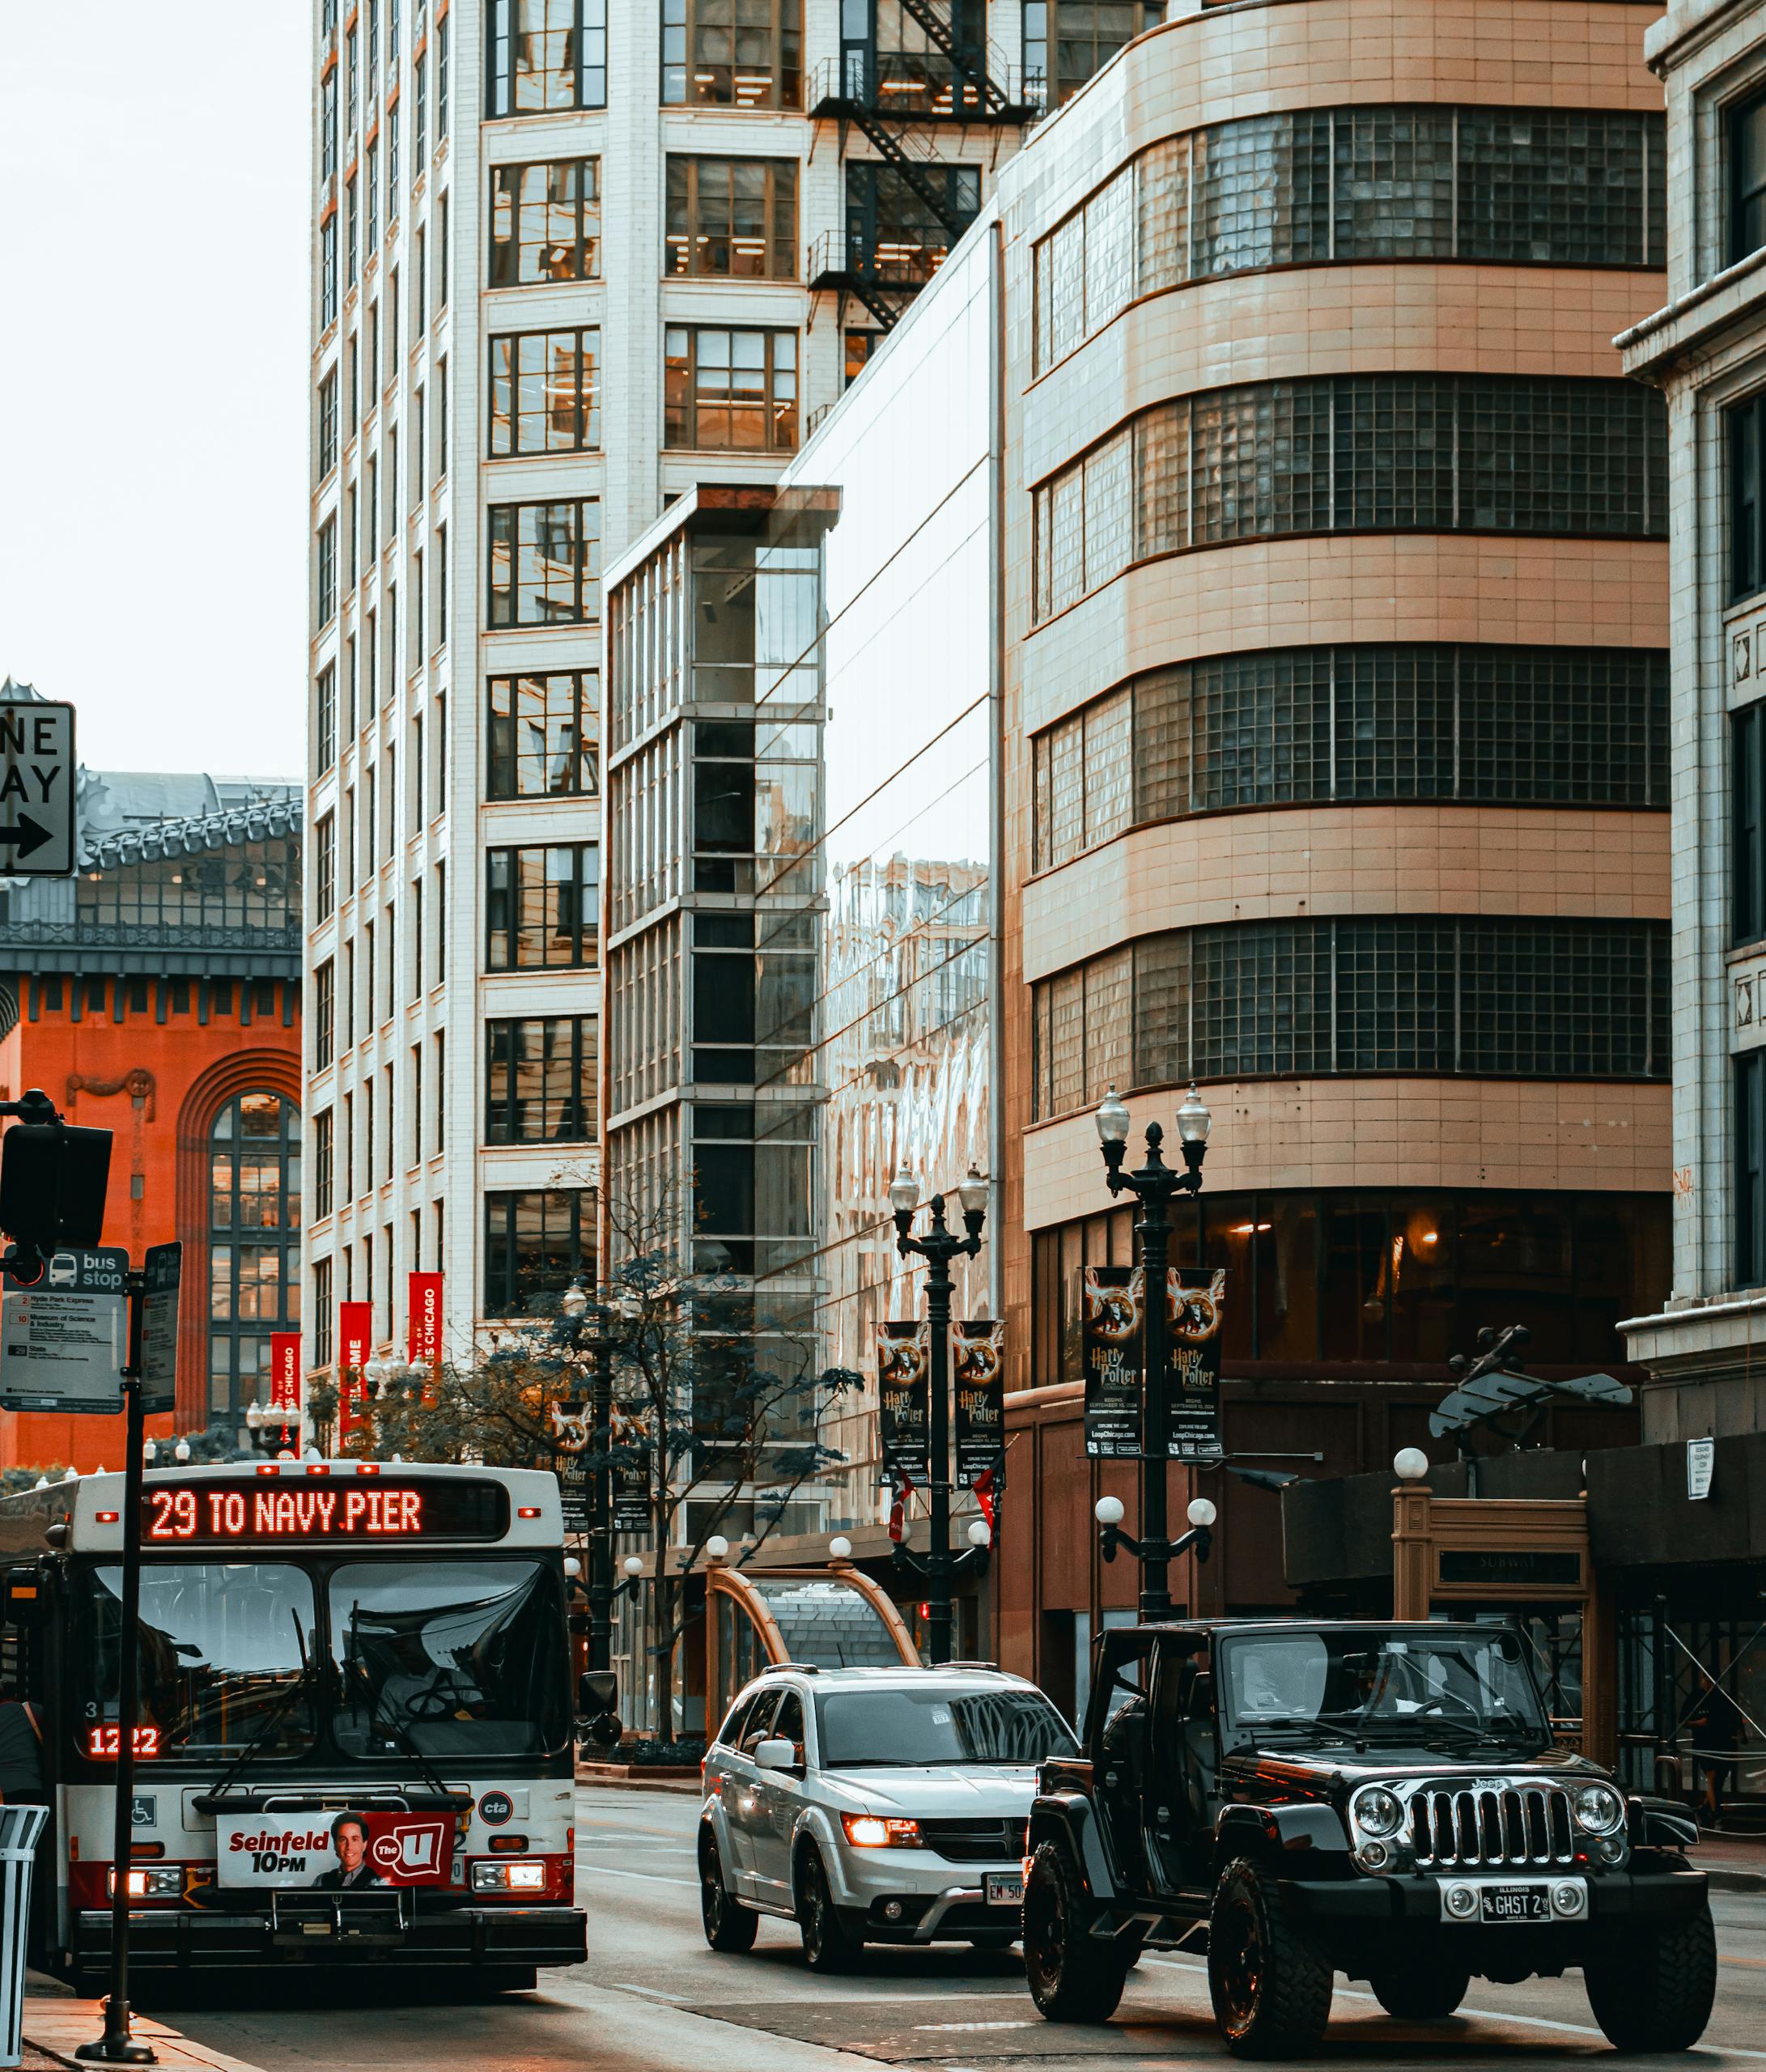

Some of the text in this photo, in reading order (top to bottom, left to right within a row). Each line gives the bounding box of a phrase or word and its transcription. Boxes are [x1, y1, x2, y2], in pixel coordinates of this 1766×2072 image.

[0, 717, 57, 755] NE
[0, 765, 62, 803] AY
[83, 1254, 117, 1270] bus
[83, 1271, 121, 1289] stop
[22, 1297, 28, 1305] 2
[31, 1295, 48, 1304] Hyde
[66, 1297, 95, 1305] Express
[70, 1314, 96, 1323] Science
[424, 1288, 435, 1346] CHICAGO
[1090, 1347, 1124, 1369] Harry
[1170, 1347, 1203, 1370] Harry
[284, 1347, 294, 1395] CHICAGO
[349, 1340, 362, 1419] ELOME
[1100, 1363, 1137, 1386] Potter
[1182, 1365, 1215, 1387] Potter
[883, 1391, 912, 1411] Harry
[958, 1390, 988, 1411] Harry
[894, 1404, 923, 1424] Potter
[969, 1404, 1000, 1424] Potter
[1091, 1430, 1136, 1439] LoopChicago.com
[1173, 1431, 1216, 1440] LoopChicago.com
[556, 1454, 578, 1471] Harry
[562, 1467, 586, 1481] Potter
[151, 1491, 421, 1536] 29 TO NAVY PIER
[85, 1701, 97, 1717] 3
[1471, 1778, 1503, 1790] Jeep
[484, 1801, 507, 1814] cta
[229, 1830, 329, 1856] Seinfeld
[378, 1845, 397, 1855] The
[1496, 1895, 1529, 1915] GHST
[1532, 1895, 1542, 1913] 2
